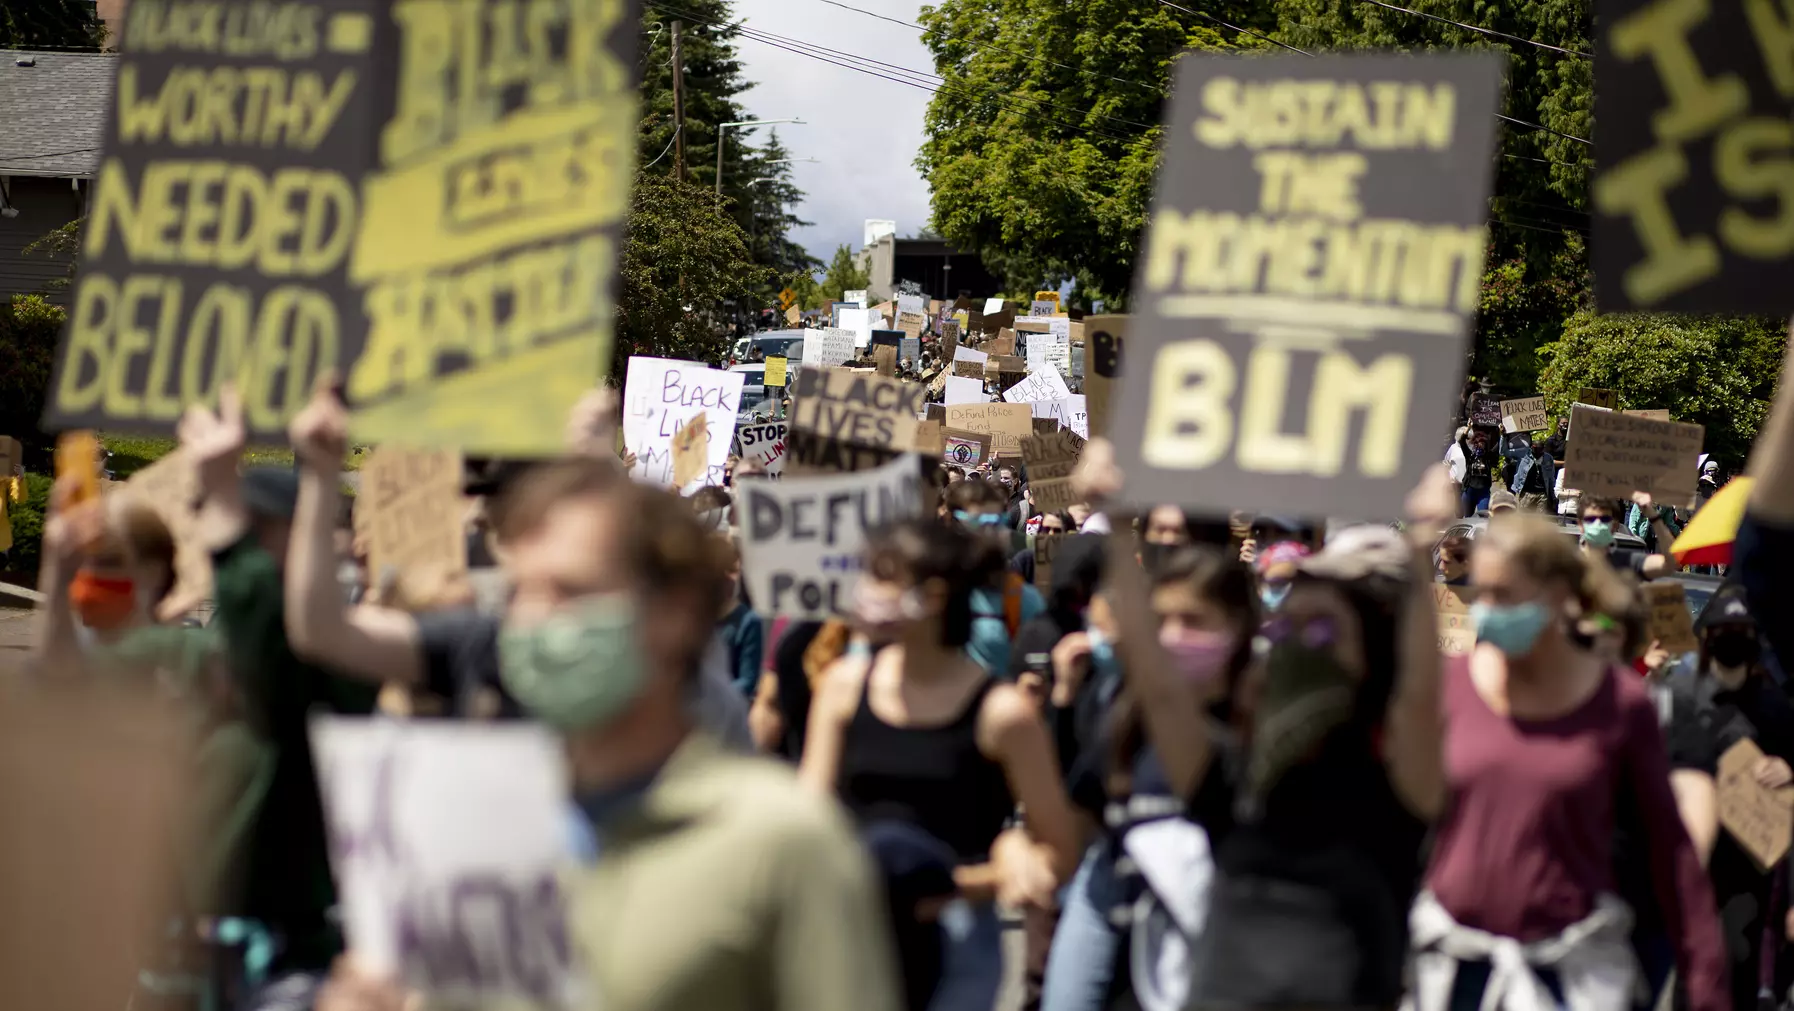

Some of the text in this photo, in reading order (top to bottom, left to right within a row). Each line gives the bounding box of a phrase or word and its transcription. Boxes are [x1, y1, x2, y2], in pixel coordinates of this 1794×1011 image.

[117, 63, 358, 151] WORTHY
[1194, 77, 1456, 149] SUSTAIN
[1252, 151, 1369, 219] THE
[85, 155, 358, 276] NEEDED
[1142, 208, 1488, 313] MOMENTUM
[663, 369, 731, 411] BLACK
[987, 405, 1014, 418] Police
[1142, 339, 1414, 477] BLM
[1504, 400, 1545, 414] BLACK LIVES
[742, 425, 787, 445] STOP
[791, 399, 895, 446] LIVES
[967, 421, 991, 431] Fund
[1520, 414, 1547, 429] MATTER
